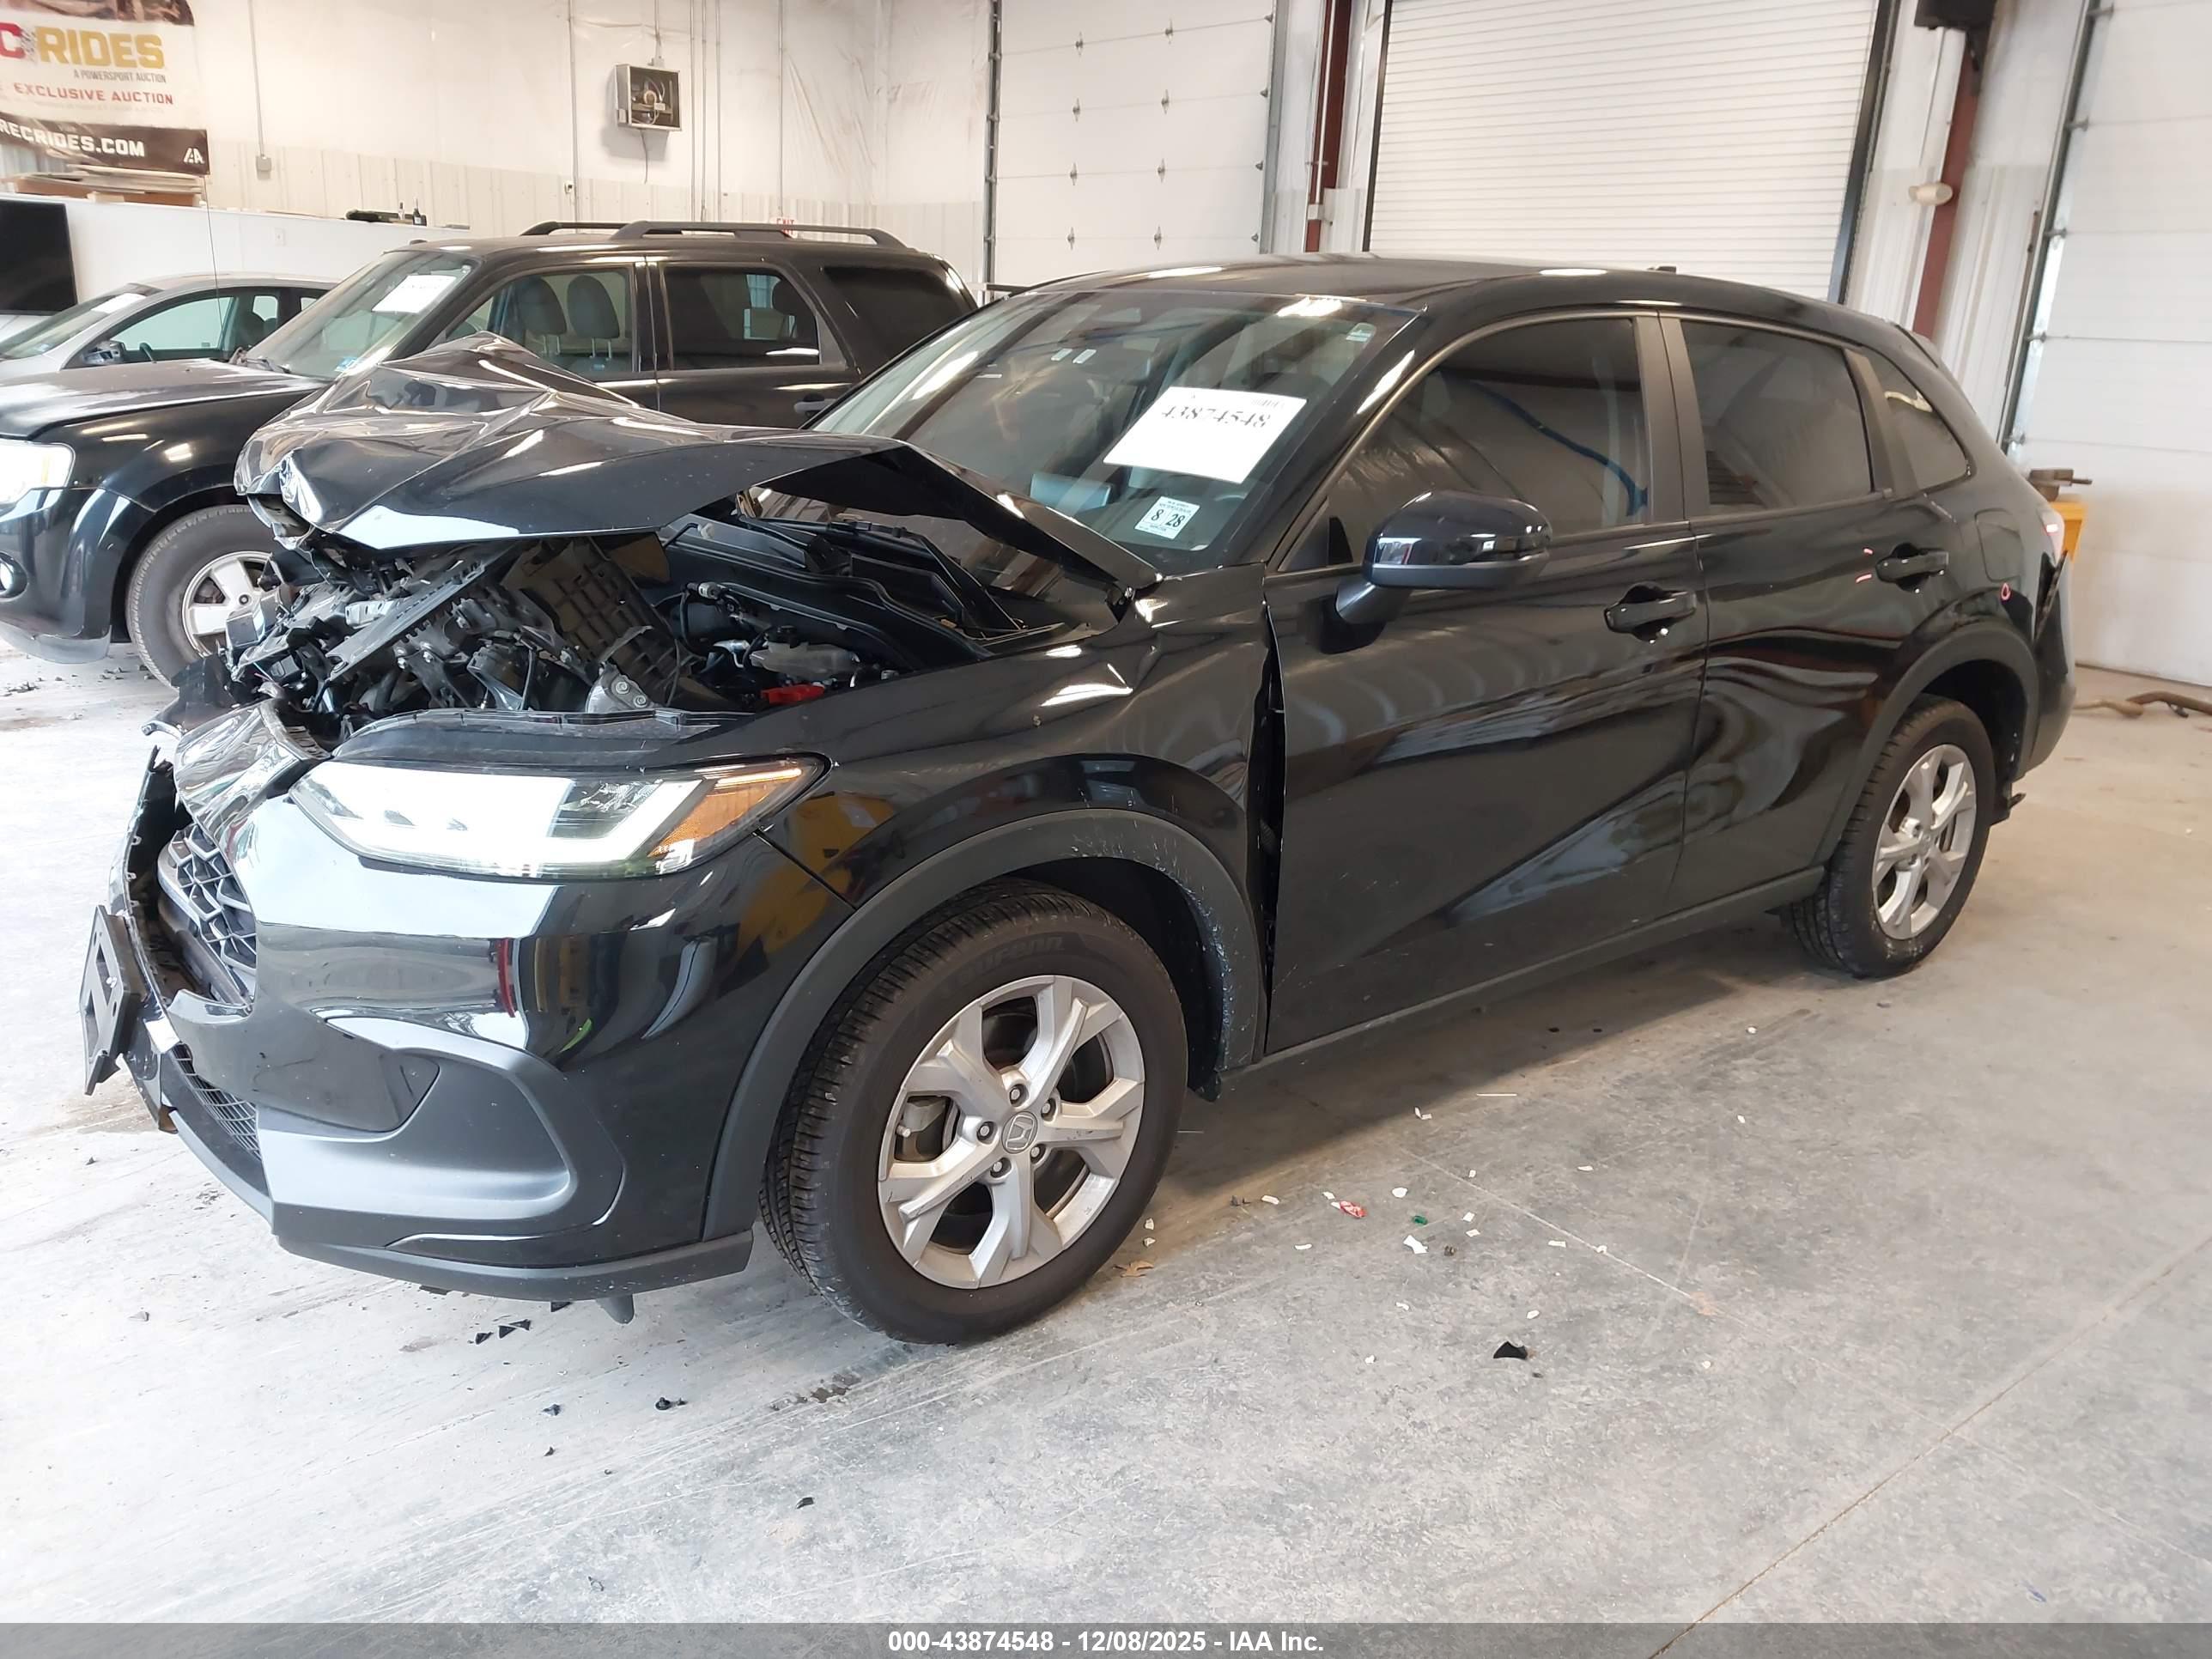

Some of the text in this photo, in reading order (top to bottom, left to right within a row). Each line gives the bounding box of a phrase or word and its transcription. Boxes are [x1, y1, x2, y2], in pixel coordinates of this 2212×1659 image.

[35, 27, 165, 69] RIDES
[74, 69, 167, 83] A POWERSPORT AUCTION
[14, 82, 106, 101] EXCLUSIVE
[112, 91, 173, 105] AUCTION
[1151, 509, 1186, 527] 8 28
